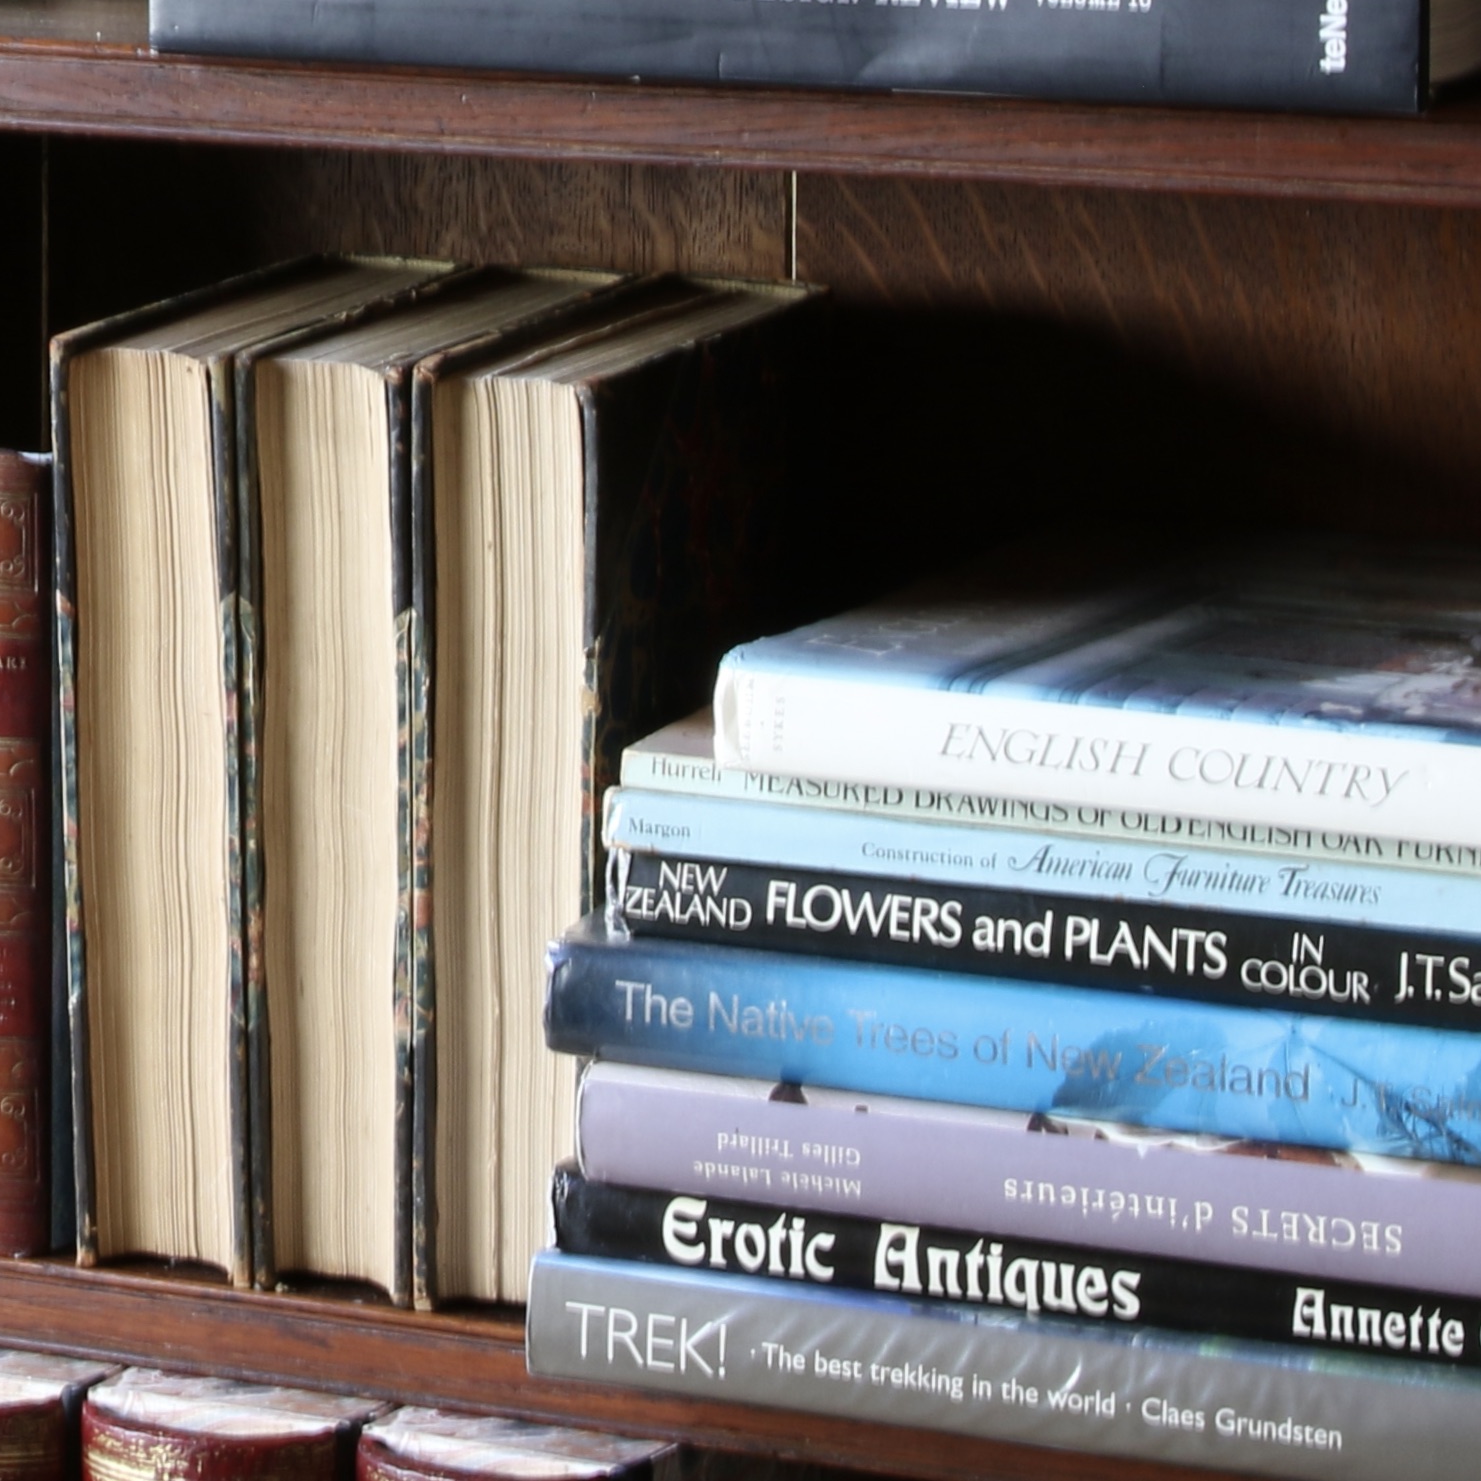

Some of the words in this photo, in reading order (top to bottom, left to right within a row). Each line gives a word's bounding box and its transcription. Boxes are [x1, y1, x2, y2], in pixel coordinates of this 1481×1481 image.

[744, 769, 904, 806] MEASURED
[940, 722, 1152, 777] ENGLISH
[1168, 746, 1411, 808] COUNTRY
[629, 818, 691, 839] Margon
[861, 843, 974, 868] Construction
[980, 855, 997, 870] of
[1008, 844, 1133, 883] American
[1143, 854, 1271, 897] Furniture
[1279, 867, 1382, 906] Treasures
[659, 863, 727, 894] NEW
[625, 887, 752, 930] ZEALAND
[766, 880, 962, 951] FLOWERS
[973, 910, 1052, 957] and
[1065, 916, 1228, 979] PLANTS
[1293, 932, 1325, 964] IN
[1241, 959, 1372, 1004] COLOUR
[616, 980, 694, 1028] The
[709, 994, 835, 1045] Native
[850, 1009, 958, 1060] Trees
[973, 1033, 1010, 1065] of
[1026, 1033, 1122, 1080] New
[1134, 1045, 1309, 1101] Zealand
[717, 1131, 792, 1158] Trillard
[801, 1141, 861, 1166] Gilles
[693, 1160, 771, 1184] Lalande
[1004, 1179, 1214, 1231] d'intérieurs
[1232, 1206, 1403, 1256] SECRETS
[662, 1196, 835, 1281] Erotic
[874, 1223, 1141, 1320] Antiques
[1293, 1287, 1465, 1357] Annette
[566, 1301, 727, 1380] TREK!
[762, 1342, 806, 1371] The
[814, 1350, 862, 1378] best
[870, 1361, 964, 1401] trekking
[972, 1375, 992, 1399] in
[1001, 1380, 1039, 1404] the
[1047, 1385, 1116, 1417] world
[1142, 1398, 1206, 1429] Claes
[1215, 1408, 1343, 1449] Grundsten
